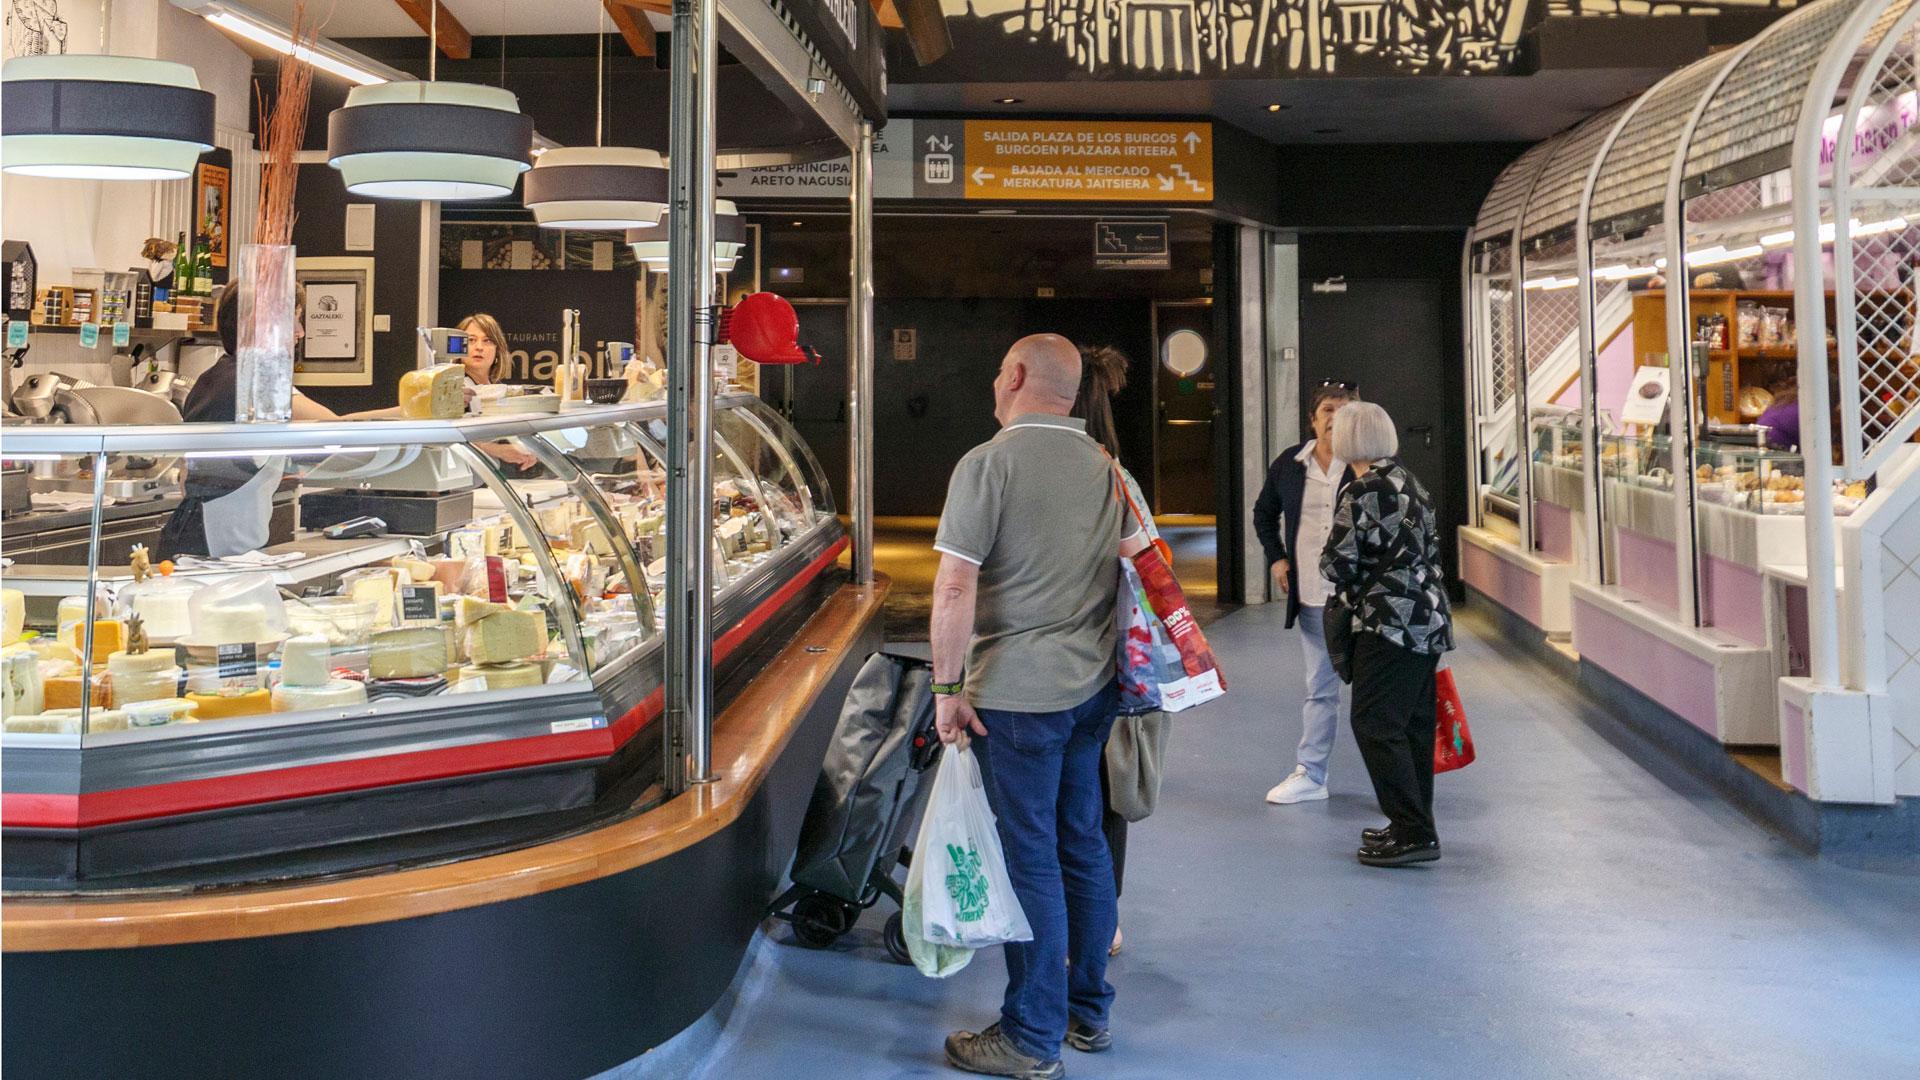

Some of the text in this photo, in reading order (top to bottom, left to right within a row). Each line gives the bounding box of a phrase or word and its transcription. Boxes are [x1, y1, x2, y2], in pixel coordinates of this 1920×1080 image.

[984, 131, 1177, 144] SALIDA PLAZA DE LOS BURGOS
[996, 144, 1177, 157] BURGOEN PLAZARA IRTEERA
[788, 162, 851, 174] PRINCIPA
[1011, 165, 1150, 177] BAJADA AL MERCADO
[750, 175, 795, 186] ARETO
[1003, 178, 1150, 190] MERKATURA JAITSIERA
[504, 332, 558, 342] TAURANTE
[1162, 605, 1191, 628] 100%
